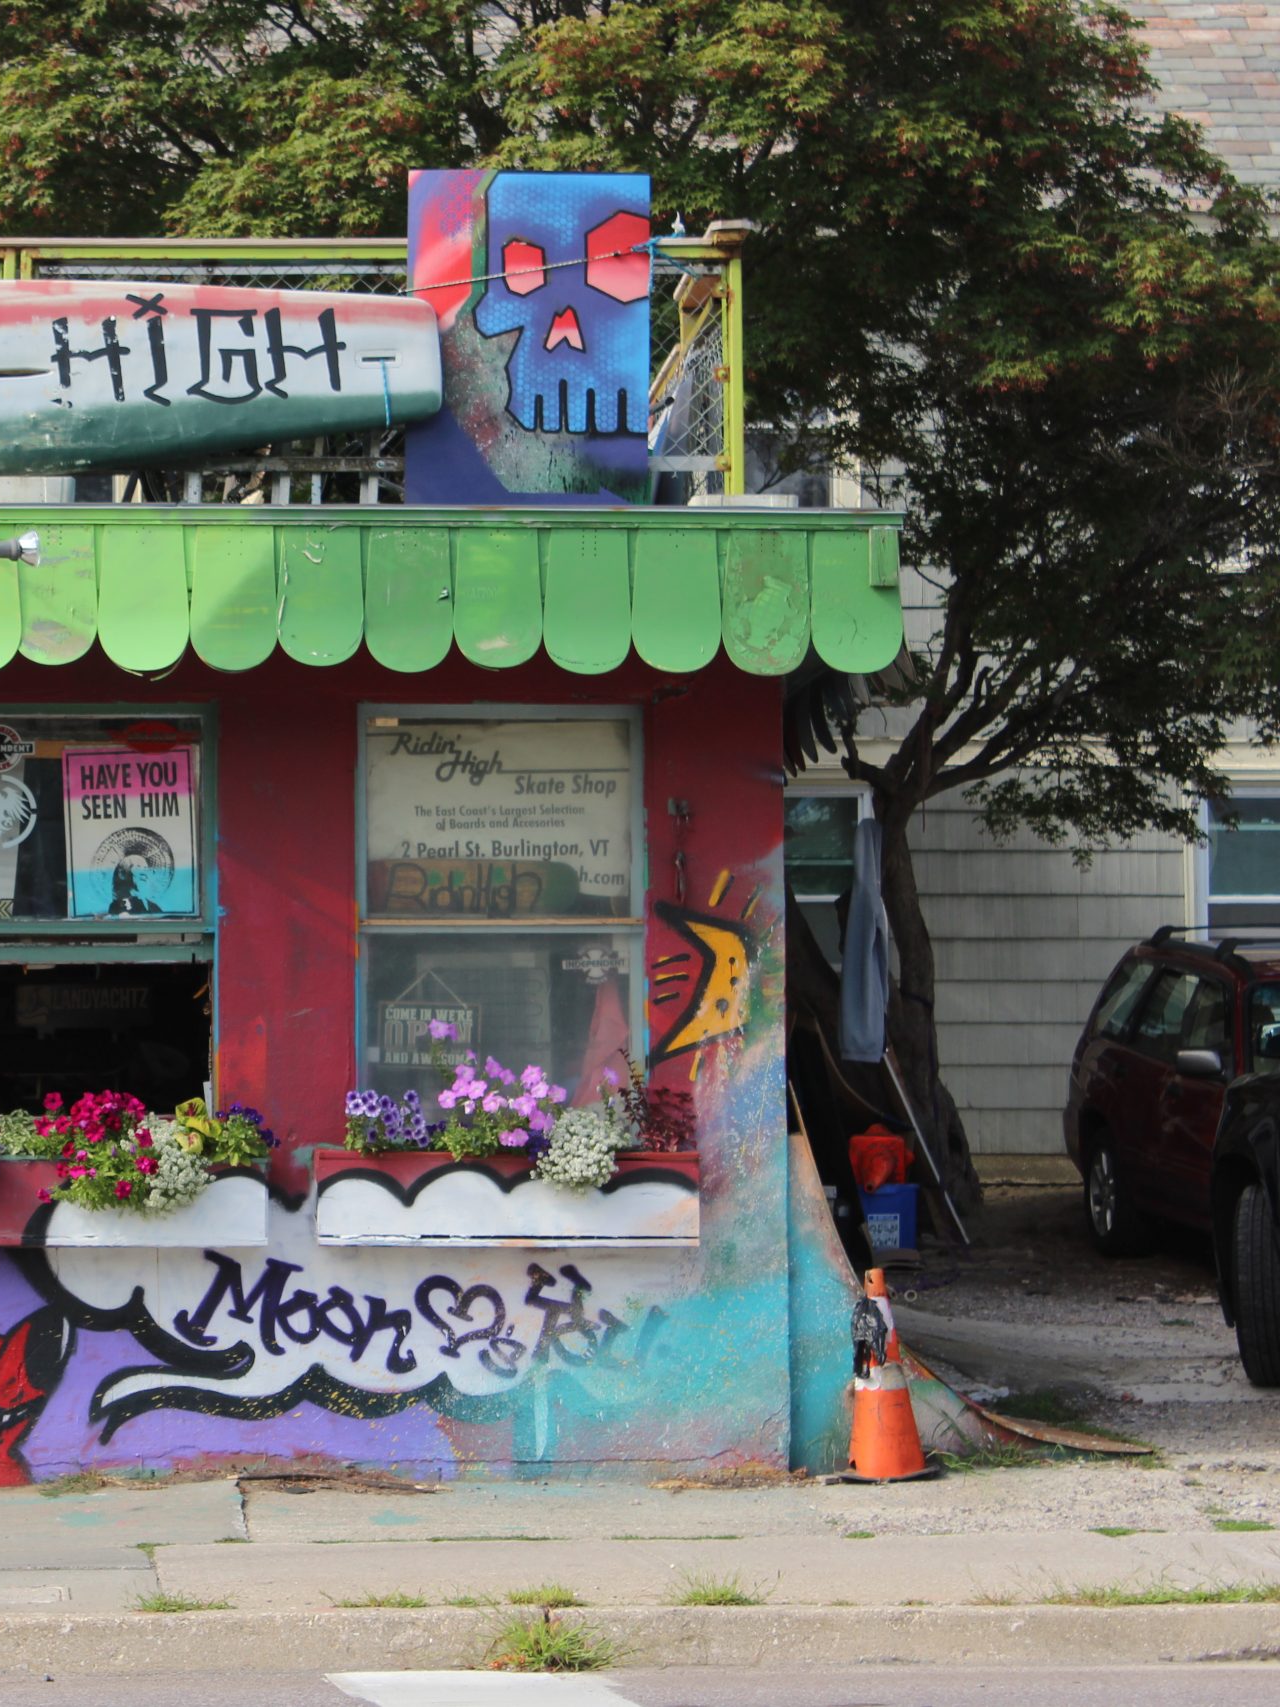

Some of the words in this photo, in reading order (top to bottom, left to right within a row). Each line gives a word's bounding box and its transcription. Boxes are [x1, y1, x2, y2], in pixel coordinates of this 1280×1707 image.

[390, 732, 461, 756] Ridin'
[80, 763, 131, 789] HAVE
[136, 762, 177, 786] YOU
[435, 750, 503, 786] High
[514, 775, 565, 795] Skate
[572, 775, 617, 798] Shop
[81, 793, 127, 820] SEEN
[139, 792, 180, 818] HIM
[414, 805, 433, 817] The
[436, 805, 456, 817] East
[459, 805, 497, 817] Coast's
[499, 805, 537, 819] Largest
[539, 804, 586, 816] Selection
[435, 818, 446, 831] of
[449, 818, 486, 830] Boards
[489, 818, 509, 829] and
[401, 840, 410, 858] 2
[417, 841, 459, 858] Pearl
[465, 841, 485, 858] St.
[491, 839, 584, 861] Burlington,
[589, 840, 610, 857] VT
[579, 866, 625, 886] h.com
[565, 959, 625, 968] INDEPENDENT
[385, 1008, 417, 1019] COME
[420, 1008, 432, 1019] IN
[384, 1020, 473, 1051] OPN
[384, 1052, 408, 1065] AND
